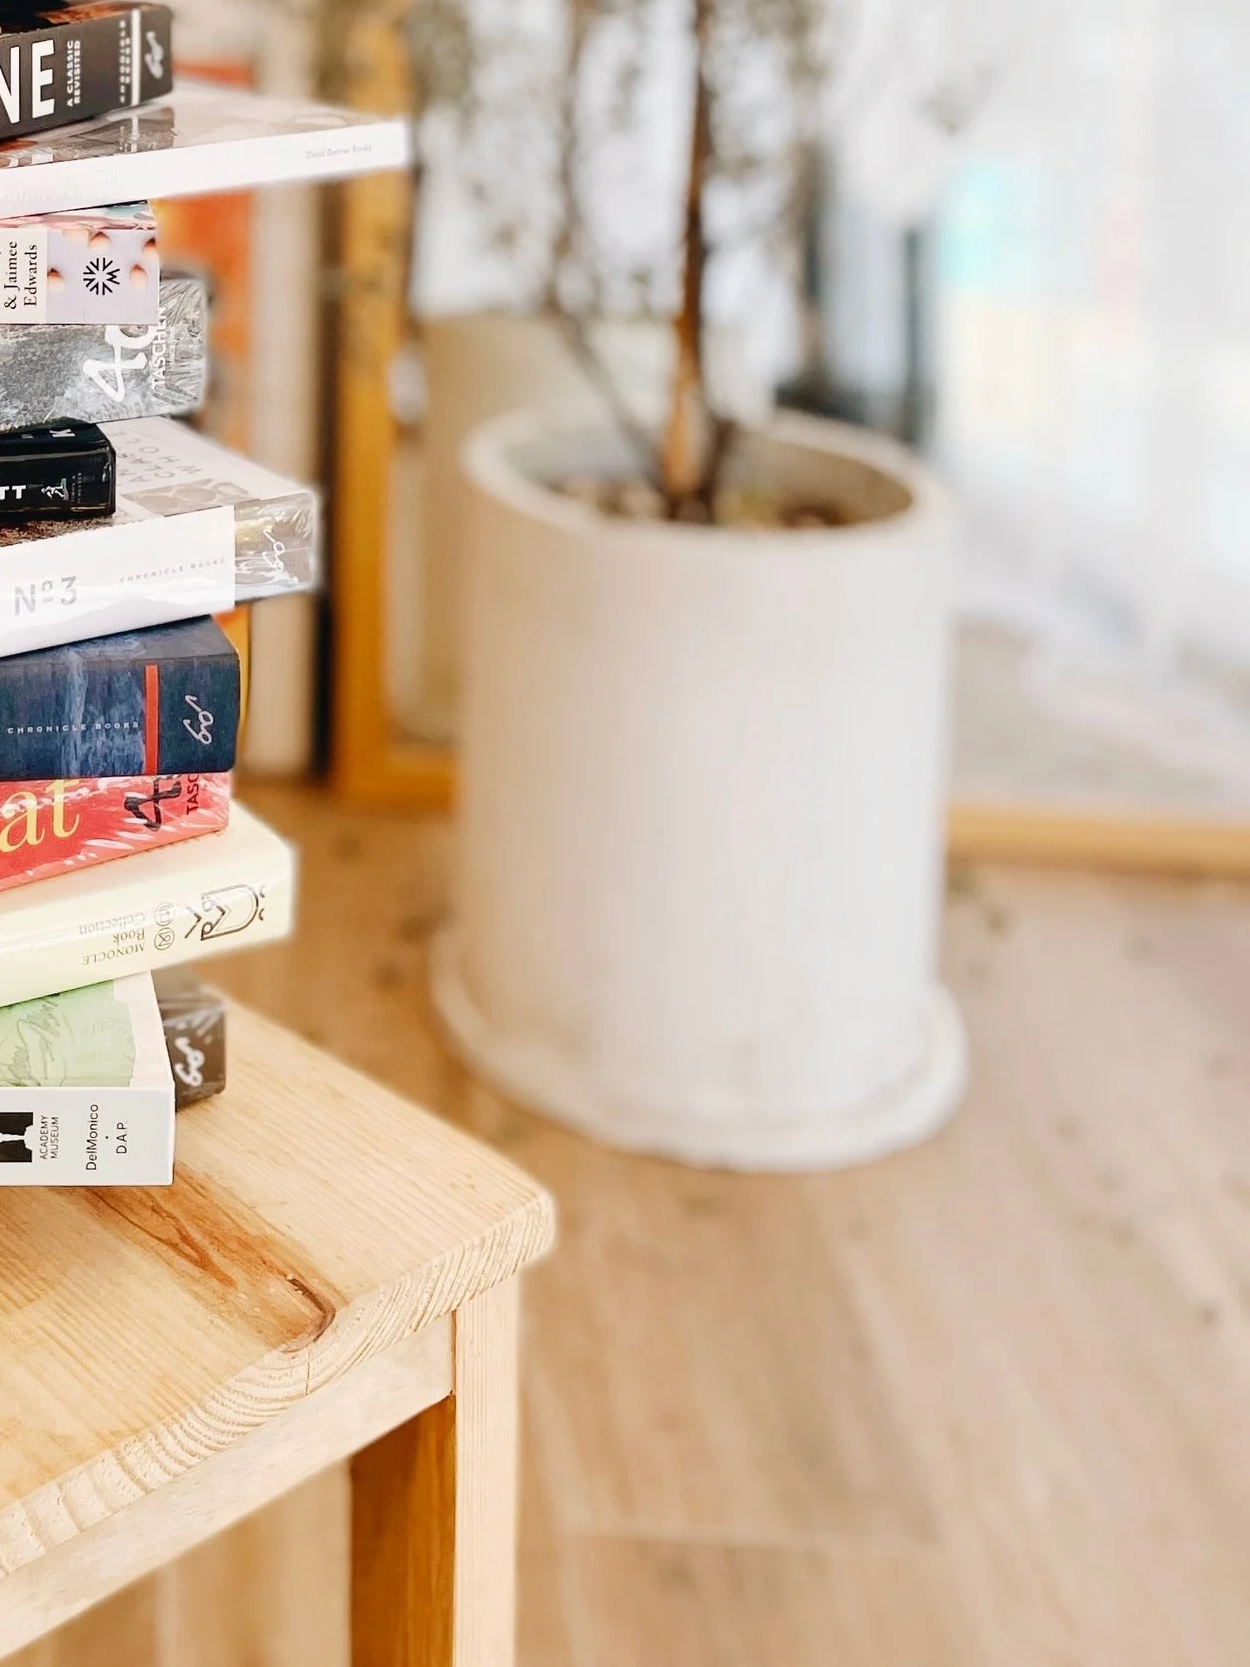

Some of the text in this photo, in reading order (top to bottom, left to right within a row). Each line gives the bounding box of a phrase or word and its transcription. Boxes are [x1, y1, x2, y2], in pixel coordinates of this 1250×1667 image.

[4, 241, 20, 309] & Jaimee
[24, 244, 38, 306] Edwards
[7, 721, 139, 735] CHRONICLE BOOKS
[78, 912, 146, 935] Collection
[113, 927, 146, 945] Book
[83, 942, 145, 966] MONOCLE
[39, 1115, 49, 1160] ACADEMY
[50, 1116, 59, 1159] MUSEUM
[86, 1104, 99, 1171] DelMonico
